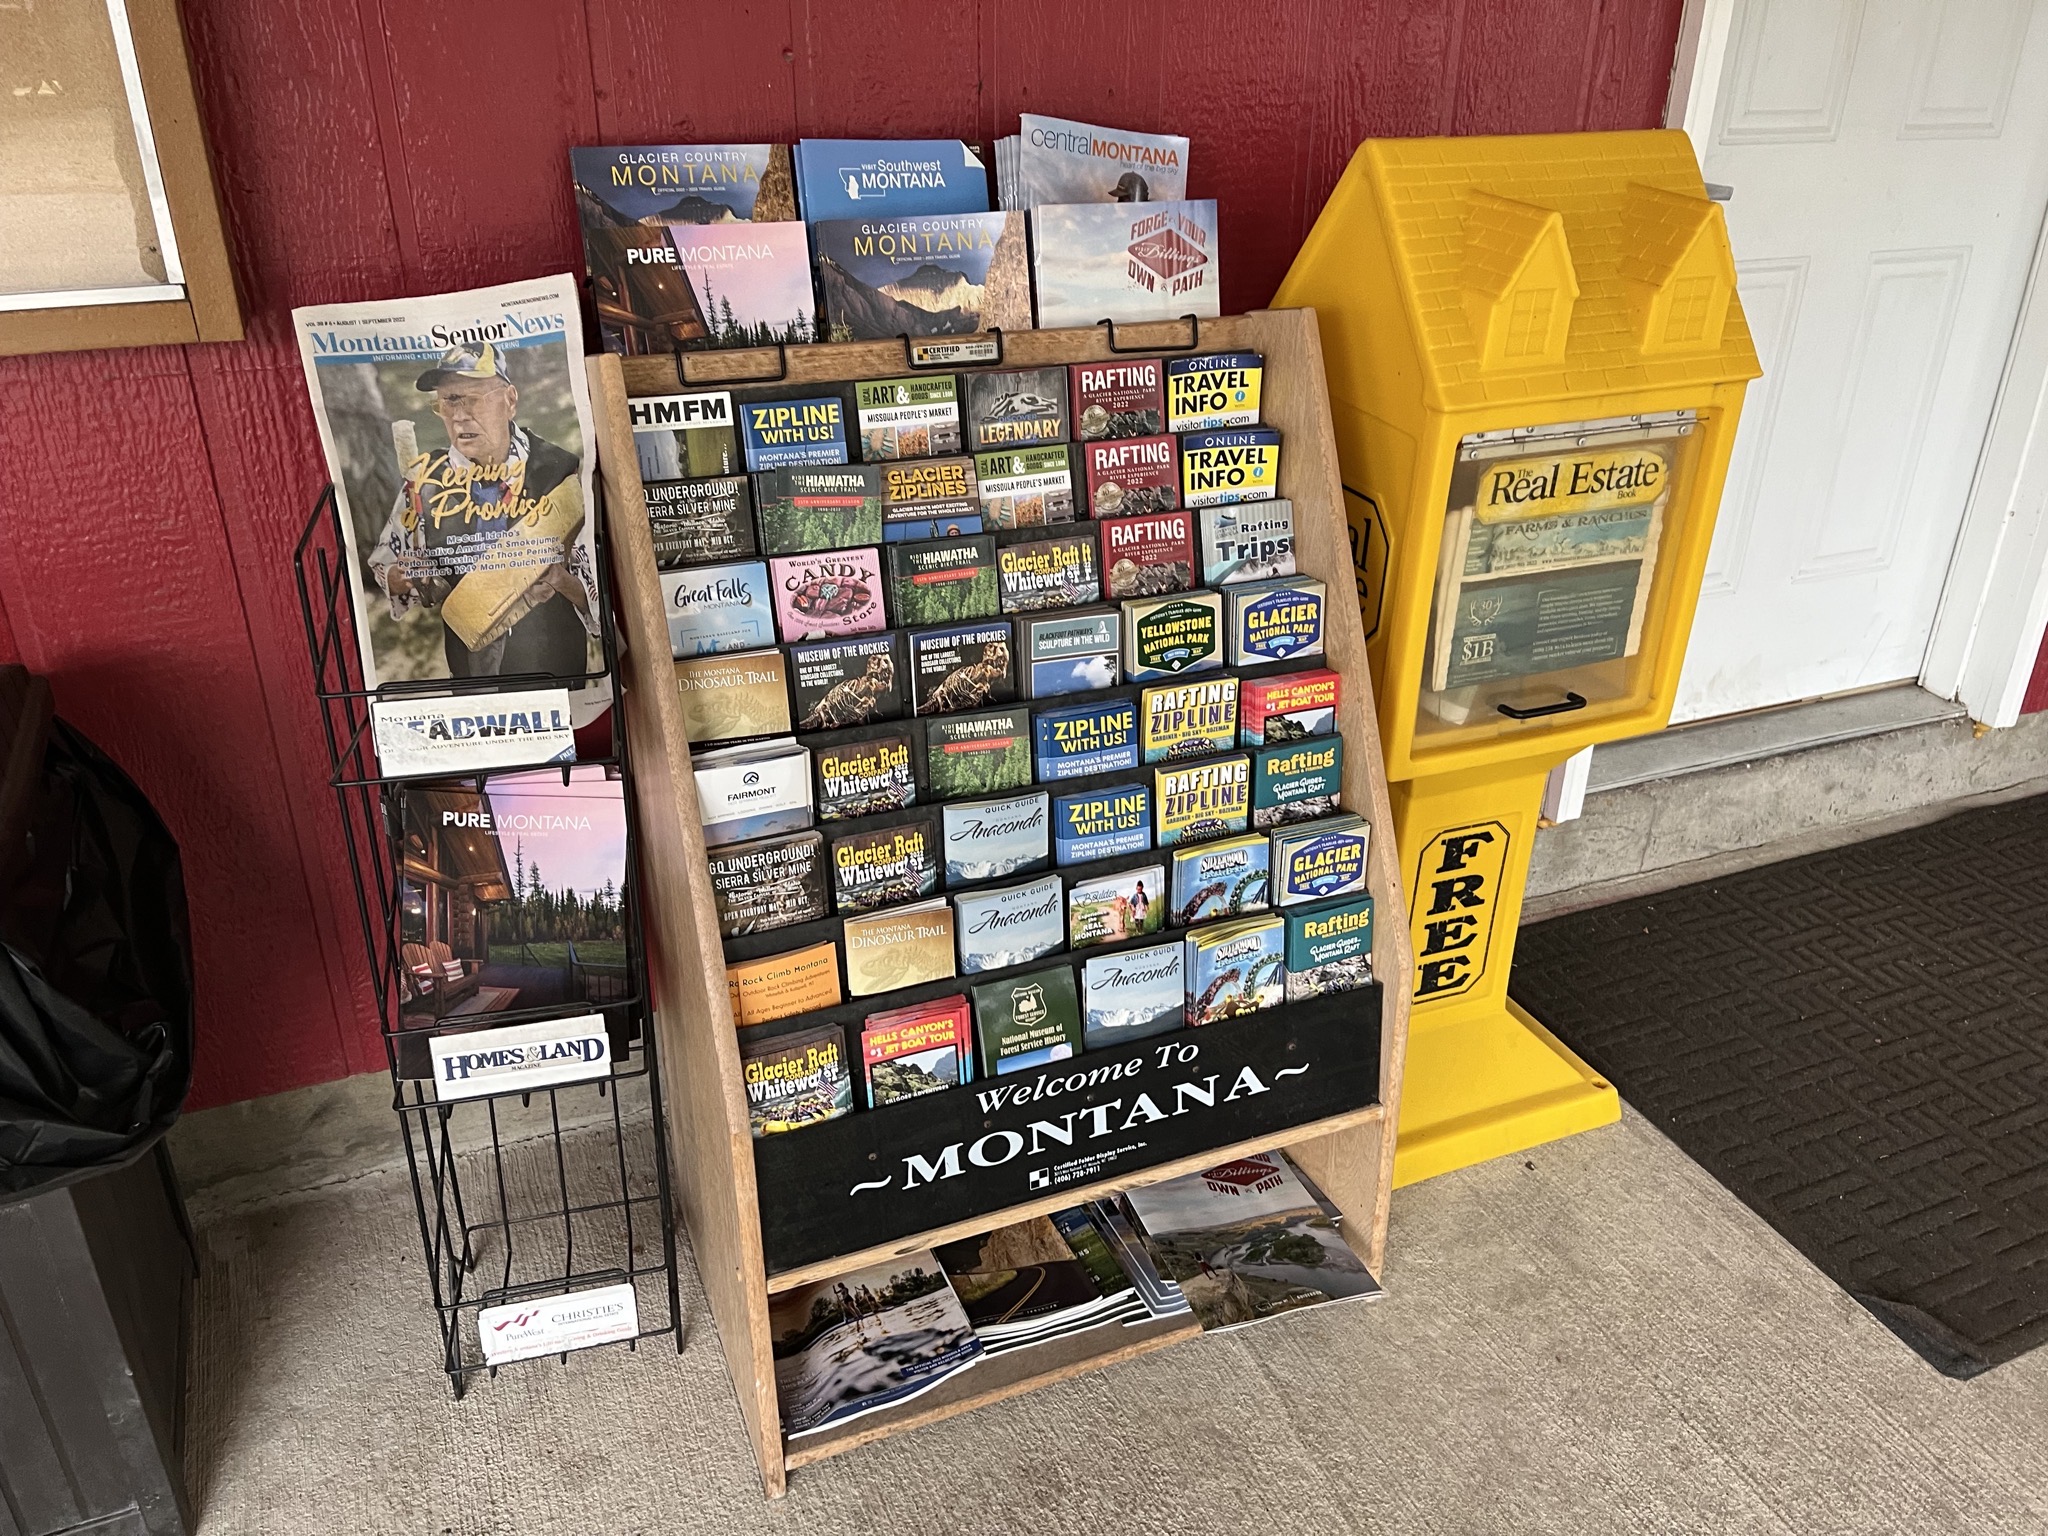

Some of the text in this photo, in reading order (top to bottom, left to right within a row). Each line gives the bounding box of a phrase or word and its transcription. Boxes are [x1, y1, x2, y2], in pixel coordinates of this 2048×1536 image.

[619, 152, 747, 164] GLACIER COUNTRY
[877, 159, 941, 173] Southwest
[611, 165, 760, 186] MONTANA
[863, 172, 945, 189] MONTANA
[1130, 211, 1206, 248] FORGE YOUR
[626, 244, 774, 265] PURE MONTANA
[1127, 259, 1203, 295] OWN PATH
[311, 312, 565, 354] MontanaSeniorNews
[929, 345, 960, 355] CERTIFIED
[1189, 358, 1237, 371] ONLINE
[1082, 365, 1155, 392] RAFTING
[1173, 371, 1249, 395] TRAVEL
[1175, 392, 1228, 415] INFO
[752, 404, 840, 429] ZIPLINE
[867, 407, 952, 423] MISSOULA PEOPLE'S MARKET
[761, 426, 835, 444] WITH US!
[980, 419, 1061, 443] LEGENDARY
[759, 449, 840, 462] MONTANA'S PREMIER
[408, 452, 526, 494] Keeping
[887, 465, 963, 484] GLACIER
[1488, 458, 1660, 506] Real Estate
[1518, 468, 1534, 478] The
[889, 480, 967, 500] ZIPLINES
[1617, 489, 1636, 499] Book
[402, 488, 553, 531] a Promise
[893, 505, 912, 513] GLACIER
[447, 530, 520, 544] McCall, Idaho's
[1241, 519, 1289, 533] Rafting
[1505, 520, 1558, 540] FARMS
[1562, 518, 1573, 528] &
[422, 549, 454, 558] Native
[456, 542, 502, 554] American
[506, 536, 560, 548] Smokejumpe
[1216, 536, 1290, 563] Trips
[785, 563, 875, 591] CANDY
[675, 578, 752, 608] Great Falls
[704, 601, 740, 610] MONTANA
[843, 602, 877, 626] Store
[1248, 603, 1317, 628] GLACIER
[1039, 628, 1093, 640] BLACKFOOT PATHWAYS
[1141, 616, 1212, 638] YELLOWSTONE
[1250, 627, 1291, 643] NATIONAL
[1293, 624, 1315, 634] PARK
[798, 641, 890, 663] MUSEUM OF THE ROCKIES
[1039, 639, 1072, 650] SCULPTURE
[1095, 634, 1110, 643] WILD
[1144, 633, 1209, 654] NATIONAL PARK
[1462, 640, 1494, 661] $1B
[1151, 682, 1236, 713] RAFTING
[381, 713, 444, 723] Montana
[955, 718, 1013, 734] HIAWATHA
[1054, 711, 1133, 741] ZIPLINE
[1152, 733, 1178, 742] GARDINER
[1207, 725, 1230, 733] BOZEMAN
[431, 741, 484, 749] ADVENTURE
[558, 747, 575, 761] FREE
[822, 745, 909, 779] Glacier Raft
[1267, 748, 1335, 776] Rafting
[727, 787, 776, 801] FAIRMONT
[985, 798, 1039, 814] QUICK GUIDE
[950, 807, 1043, 841] Anaconda
[709, 845, 815, 874] GO UNDERGROUND!
[716, 861, 812, 889] SIERRA SILVER MINE
[1085, 890, 1116, 905] Boulder
[1414, 831, 1494, 997] FREE
[852, 925, 946, 949] DINOSAUR TRAIL
[876, 924, 911, 934] MONTANA
[743, 958, 828, 986] Rock Climb Montana
[772, 1002, 796, 1010] Beginner
[806, 988, 832, 1001] Advanced
[870, 1020, 954, 1047] HELLS CANYON'S
[870, 1031, 955, 1057] #1 JET BOAT TOUR
[1002, 1023, 1063, 1044] National Museum of
[1001, 1034, 1066, 1056] Forest Service History
[511, 1063, 541, 1071] MAGAZINE
[975, 1042, 1199, 1114] Welcome To
[901, 1066, 1269, 1191] MONTANA
[1054, 1160, 1077, 1171] Certified
[1079, 1156, 1095, 1164] Folder
[1097, 1151, 1116, 1159] Display
[1117, 1145, 1136, 1153] Service,
[1055, 1166, 1100, 1185] (406) 728-7911
[505, 1328, 544, 1342] PureWest
[551, 1302, 623, 1323] CHRISTIE'S
